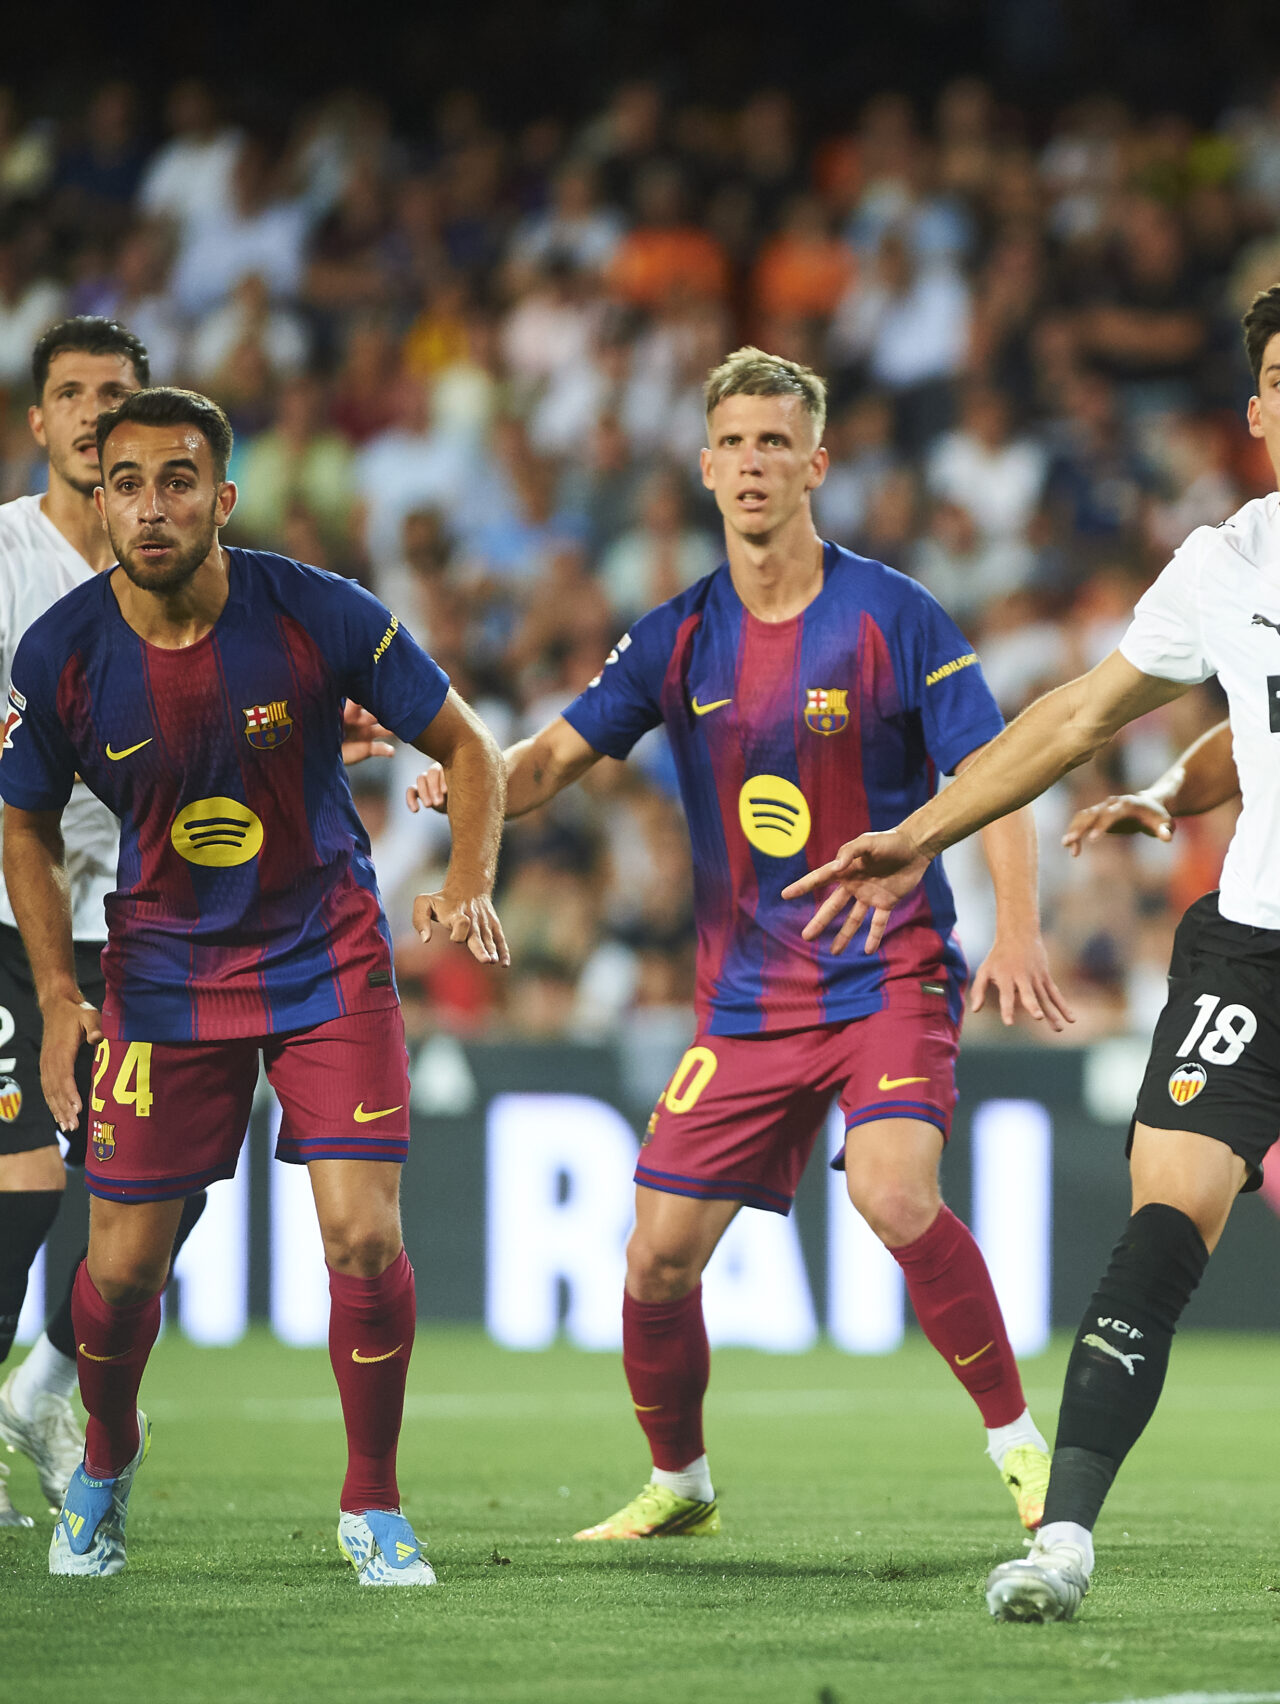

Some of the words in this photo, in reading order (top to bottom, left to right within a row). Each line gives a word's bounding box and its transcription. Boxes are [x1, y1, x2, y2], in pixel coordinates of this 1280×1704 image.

[373, 612, 399, 665] AMBILIG
[1175, 993, 1258, 1066] 18
[91, 1037, 154, 1117] 24
[658, 1046, 718, 1114] 0
[1097, 1316, 1144, 1339] VCF
